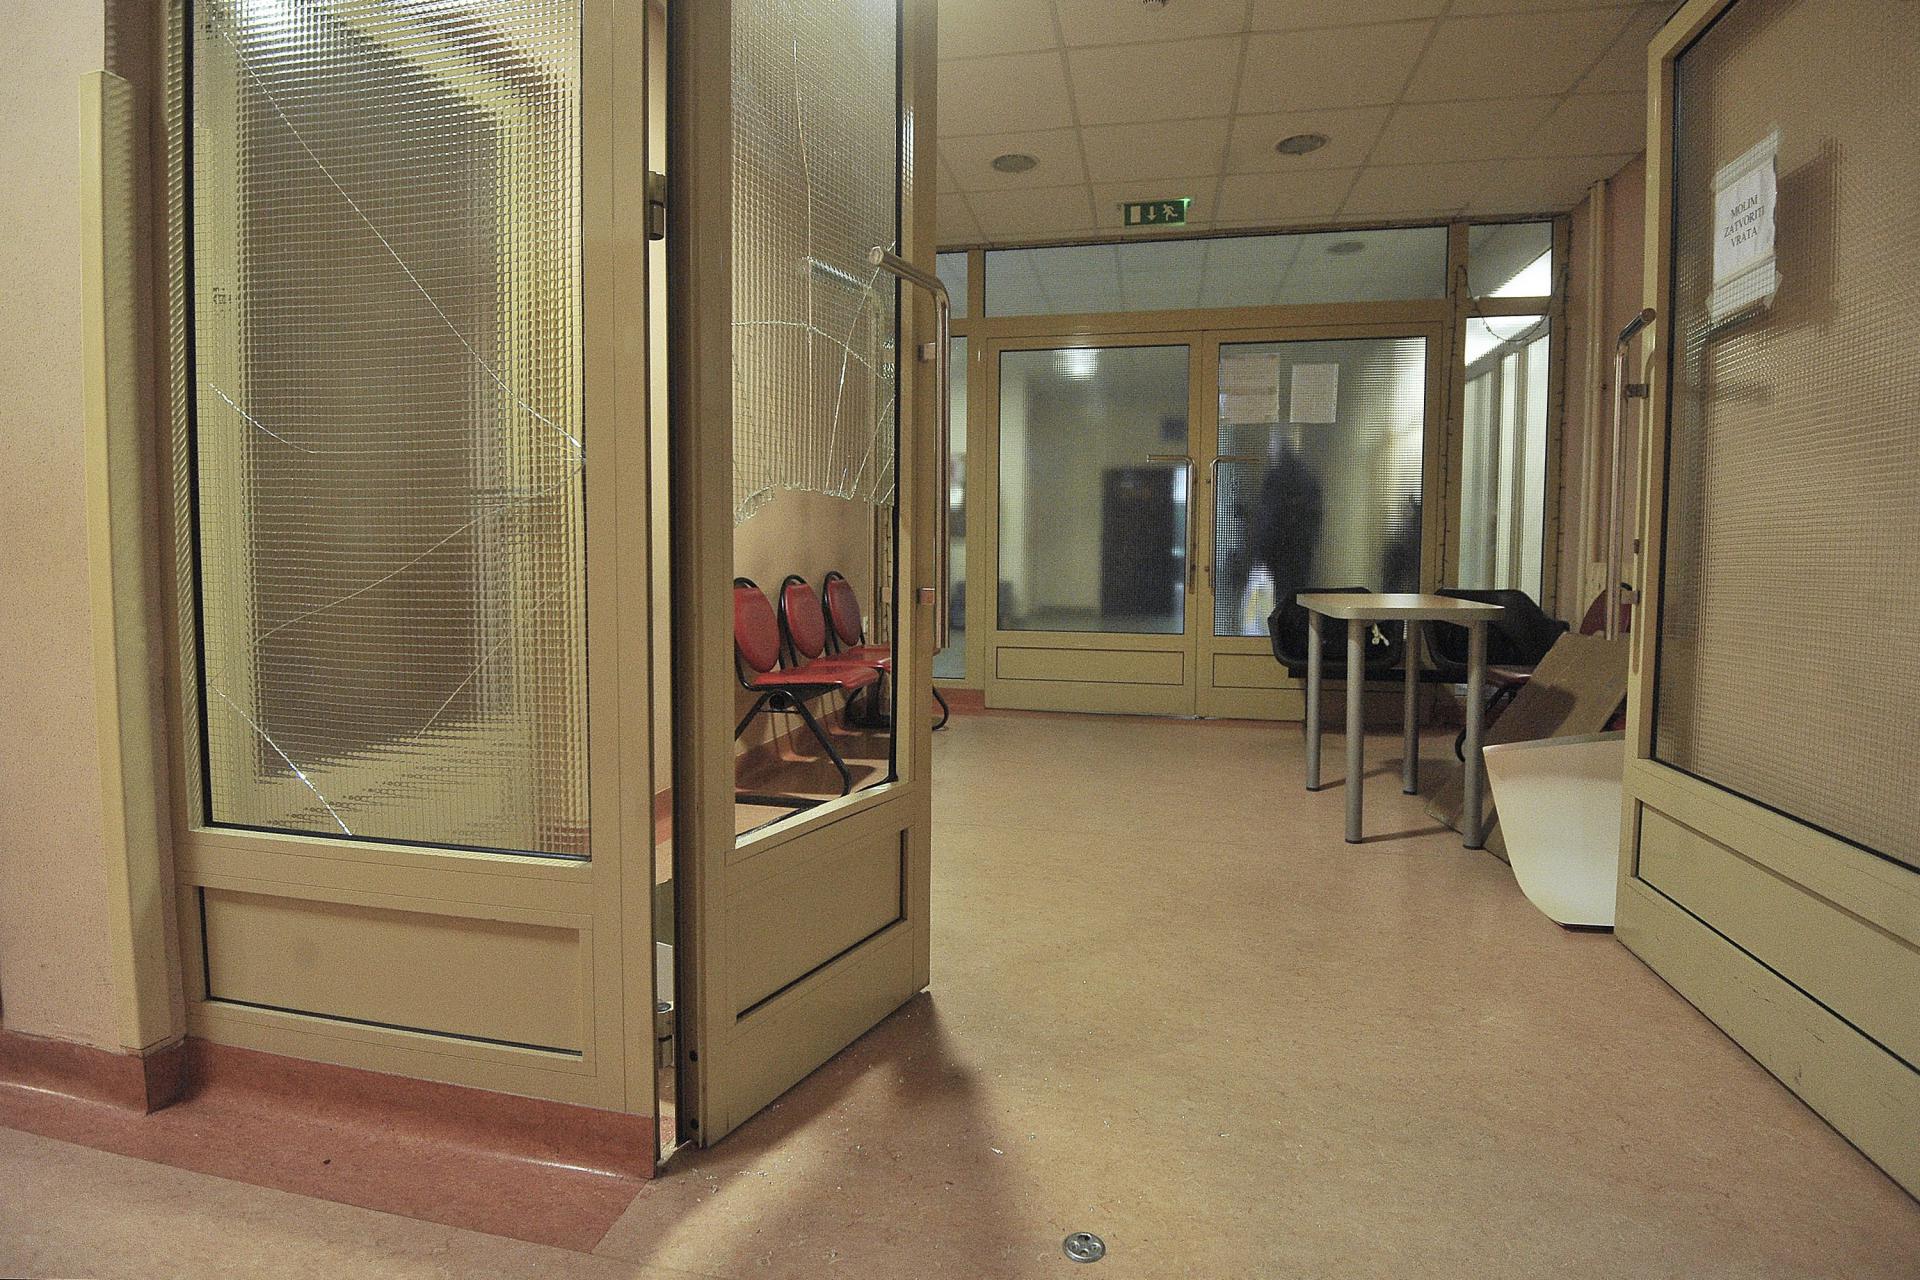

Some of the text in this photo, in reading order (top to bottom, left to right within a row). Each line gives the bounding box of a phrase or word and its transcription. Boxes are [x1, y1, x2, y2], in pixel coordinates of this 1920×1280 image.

[1730, 195, 1758, 218] MOLIM
[1723, 206, 1765, 239] ZATVORITI
[1730, 227, 1758, 248] VRATA
